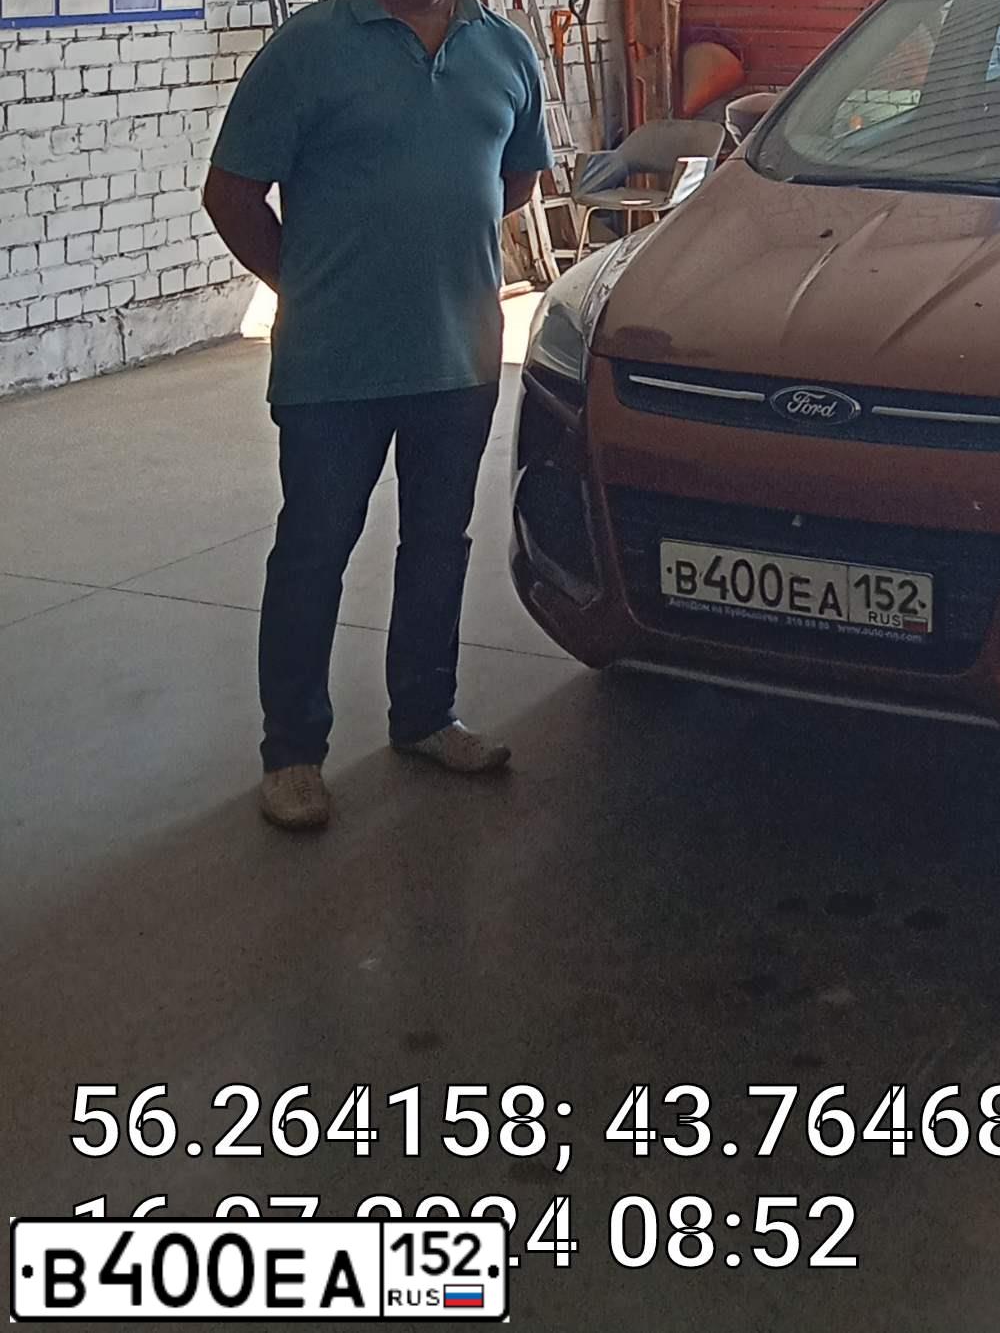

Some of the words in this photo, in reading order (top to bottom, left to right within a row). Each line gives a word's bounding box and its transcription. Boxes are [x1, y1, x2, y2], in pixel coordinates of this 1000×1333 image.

[786, 390, 838, 418] Ford
[674, 554, 844, 618] В400ЕА
[853, 573, 919, 616] 152
[867, 610, 902, 627] RUS
